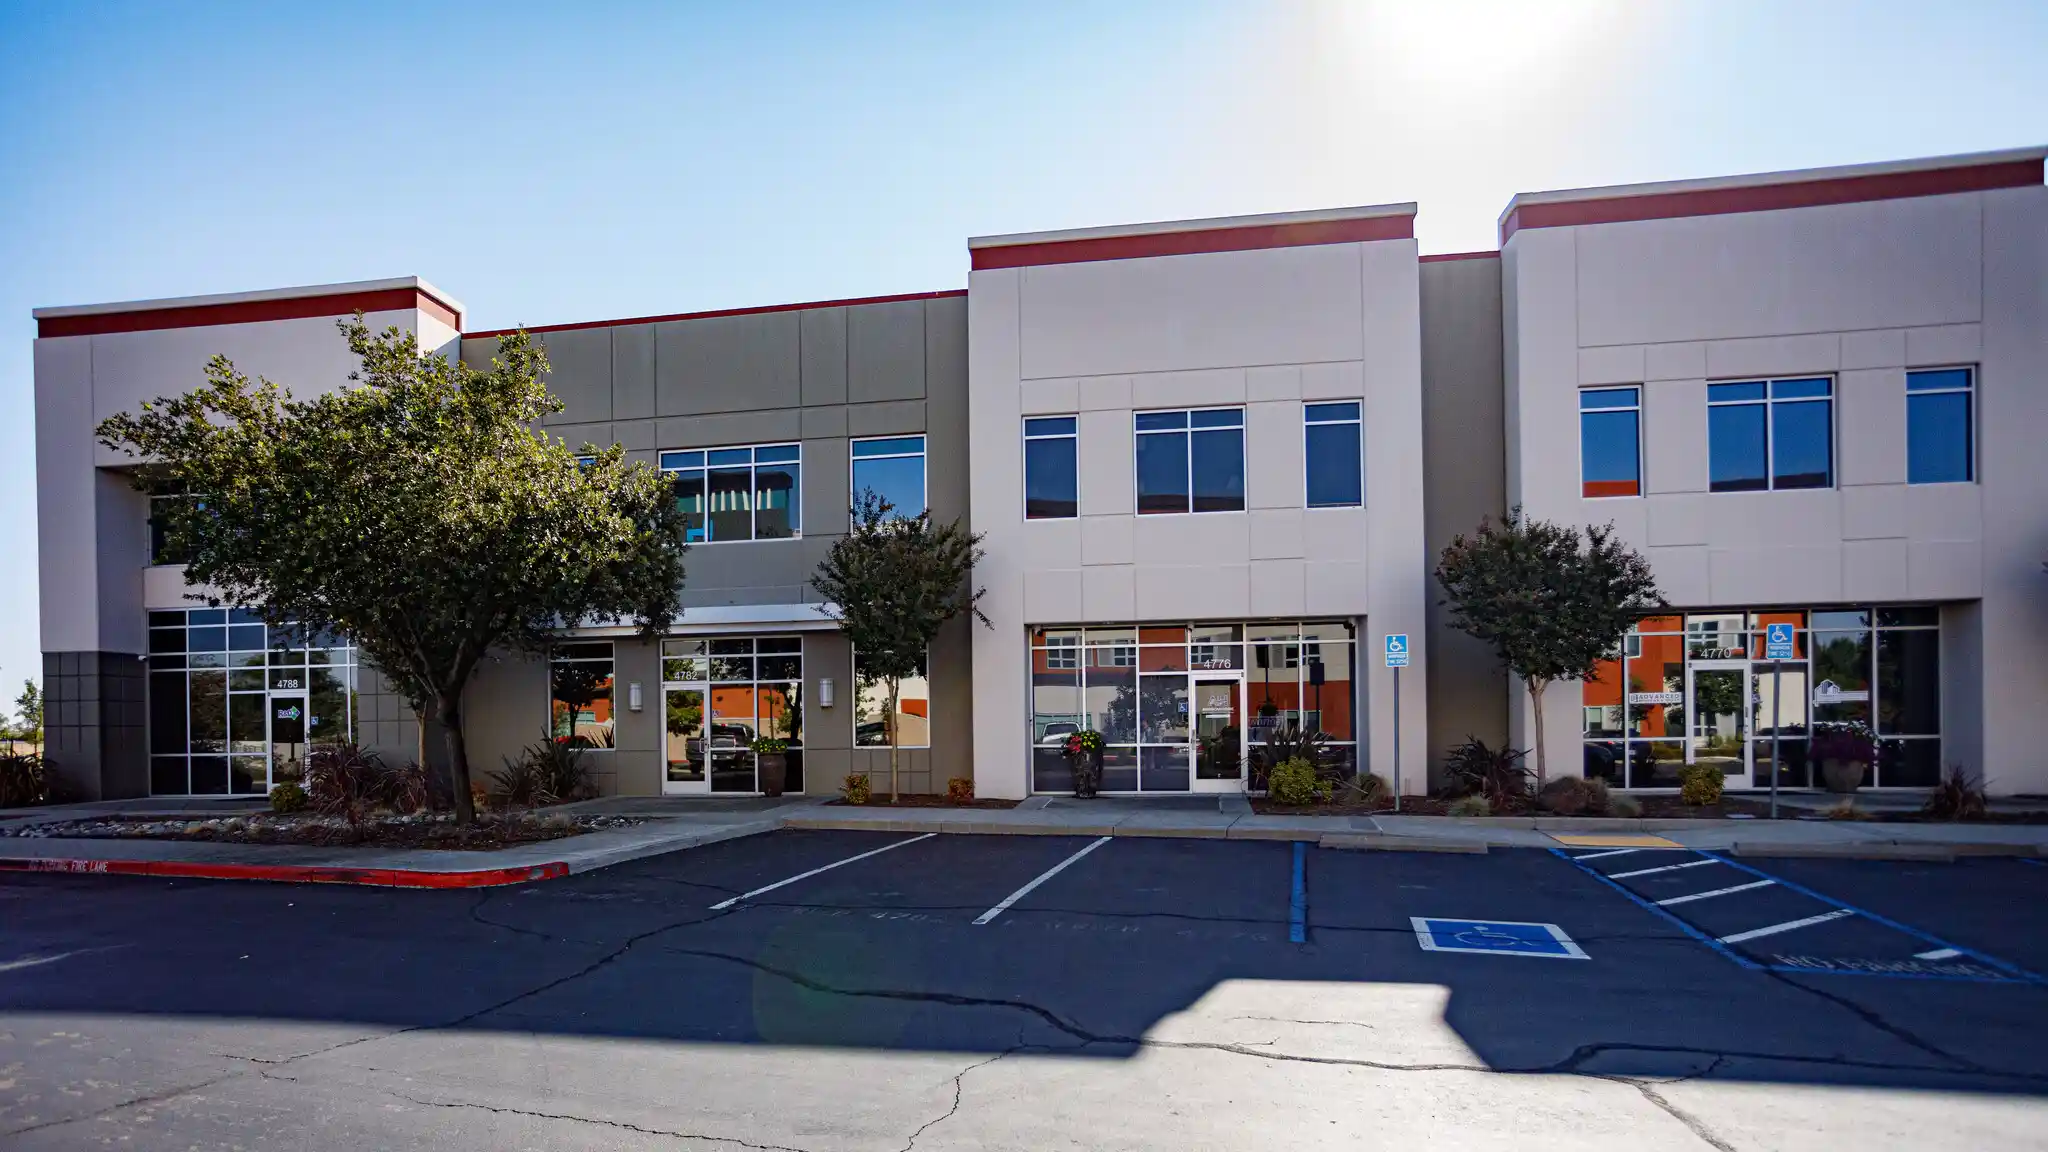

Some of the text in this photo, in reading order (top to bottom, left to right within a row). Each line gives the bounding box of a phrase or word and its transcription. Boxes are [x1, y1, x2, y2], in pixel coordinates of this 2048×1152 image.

[1701, 648, 1732, 658] 4770
[1204, 659, 1231, 669] 4776
[675, 671, 698, 680] 4782
[277, 679, 299, 688] 4788
[71, 860, 88, 873] FIRE
[89, 861, 109, 873] LANE
